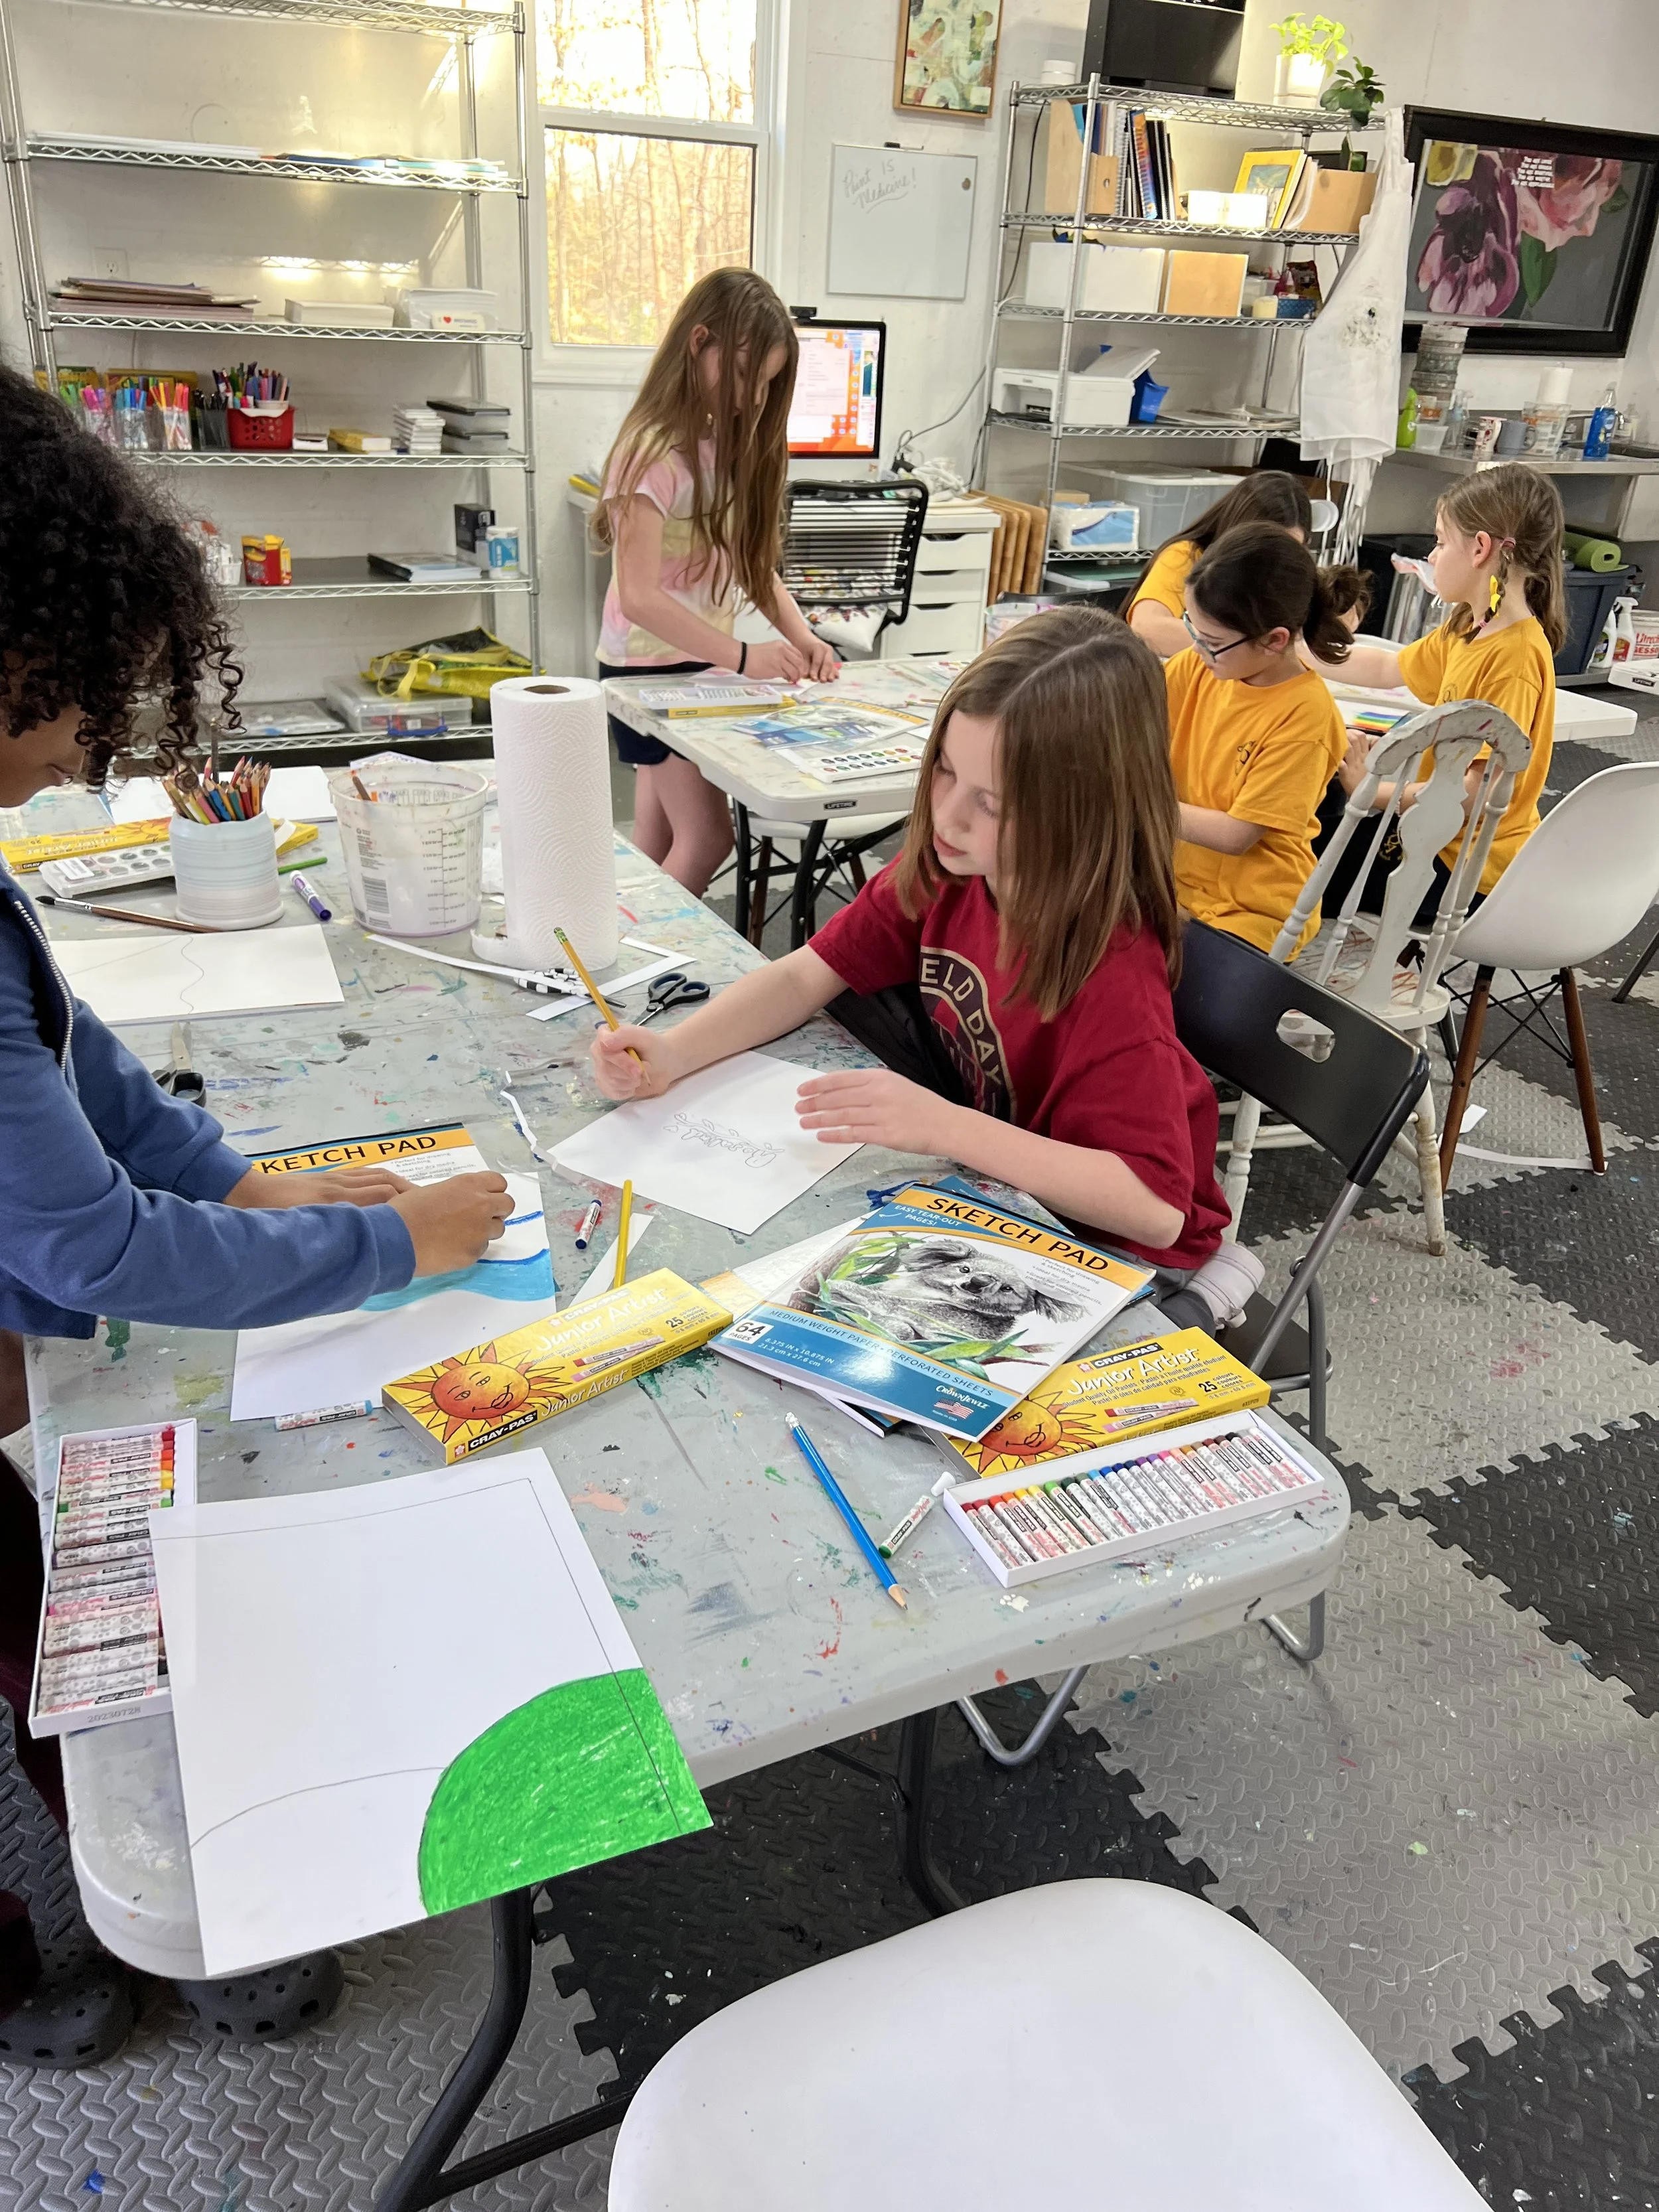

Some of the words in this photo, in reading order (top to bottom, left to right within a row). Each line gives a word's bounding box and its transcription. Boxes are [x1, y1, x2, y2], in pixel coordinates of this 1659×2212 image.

[921, 958, 975, 1001] ELD
[259, 1145, 366, 1174] KETCH
[377, 1136, 437, 1155] PAD
[894, 1204, 917, 1214] EASY
[918, 1209, 963, 1226] TEAR-OUT
[904, 1213, 938, 1226] PAGES!
[926, 1198, 1043, 1244] SKETCH
[1047, 1240, 1109, 1272] PAD
[536, 1315, 603, 1352] Junior
[608, 1288, 666, 1323] Artist
[666, 1316, 684, 1328] 25
[735, 1321, 766, 1337] 64
[728, 1331, 753, 1341] PAGES
[757, 1343, 775, 1351] 21.3
[792, 1353, 808, 1363] 27.6
[764, 1337, 786, 1347] 8.375
[800, 1348, 826, 1361] 10.875
[769, 1309, 807, 1325] MEDIUM
[808, 1320, 848, 1337] WEIGHT
[848, 1333, 881, 1351] PAPER
[887, 1348, 951, 1379] PERFORATED
[952, 1376, 994, 1397] SHEETS
[1093, 1343, 1159, 1368] CRAY-PAS
[1067, 1366, 1134, 1396] Junior
[1137, 1348, 1200, 1377] Artist
[1212, 1372, 1235, 1382] colours
[1216, 1375, 1243, 1386] couleurs
[1221, 1380, 1244, 1388] colores
[1061, 1396, 1086, 1408] Student
[1085, 1390, 1108, 1401] Quality
[1115, 1381, 1138, 1392] Pastels
[1139, 1374, 1160, 1384] Pastel
[1092, 1396, 1113, 1406] Pastel
[1141, 1380, 1165, 1391] calidad
[1163, 1376, 1177, 1386] para
[1177, 1367, 1211, 1380] estudiantes
[1198, 1380, 1218, 1393] 25
[469, 1413, 535, 1449] CRAY-PAS
[541, 1392, 586, 1417] Junior
[587, 1369, 629, 1398] Artist
